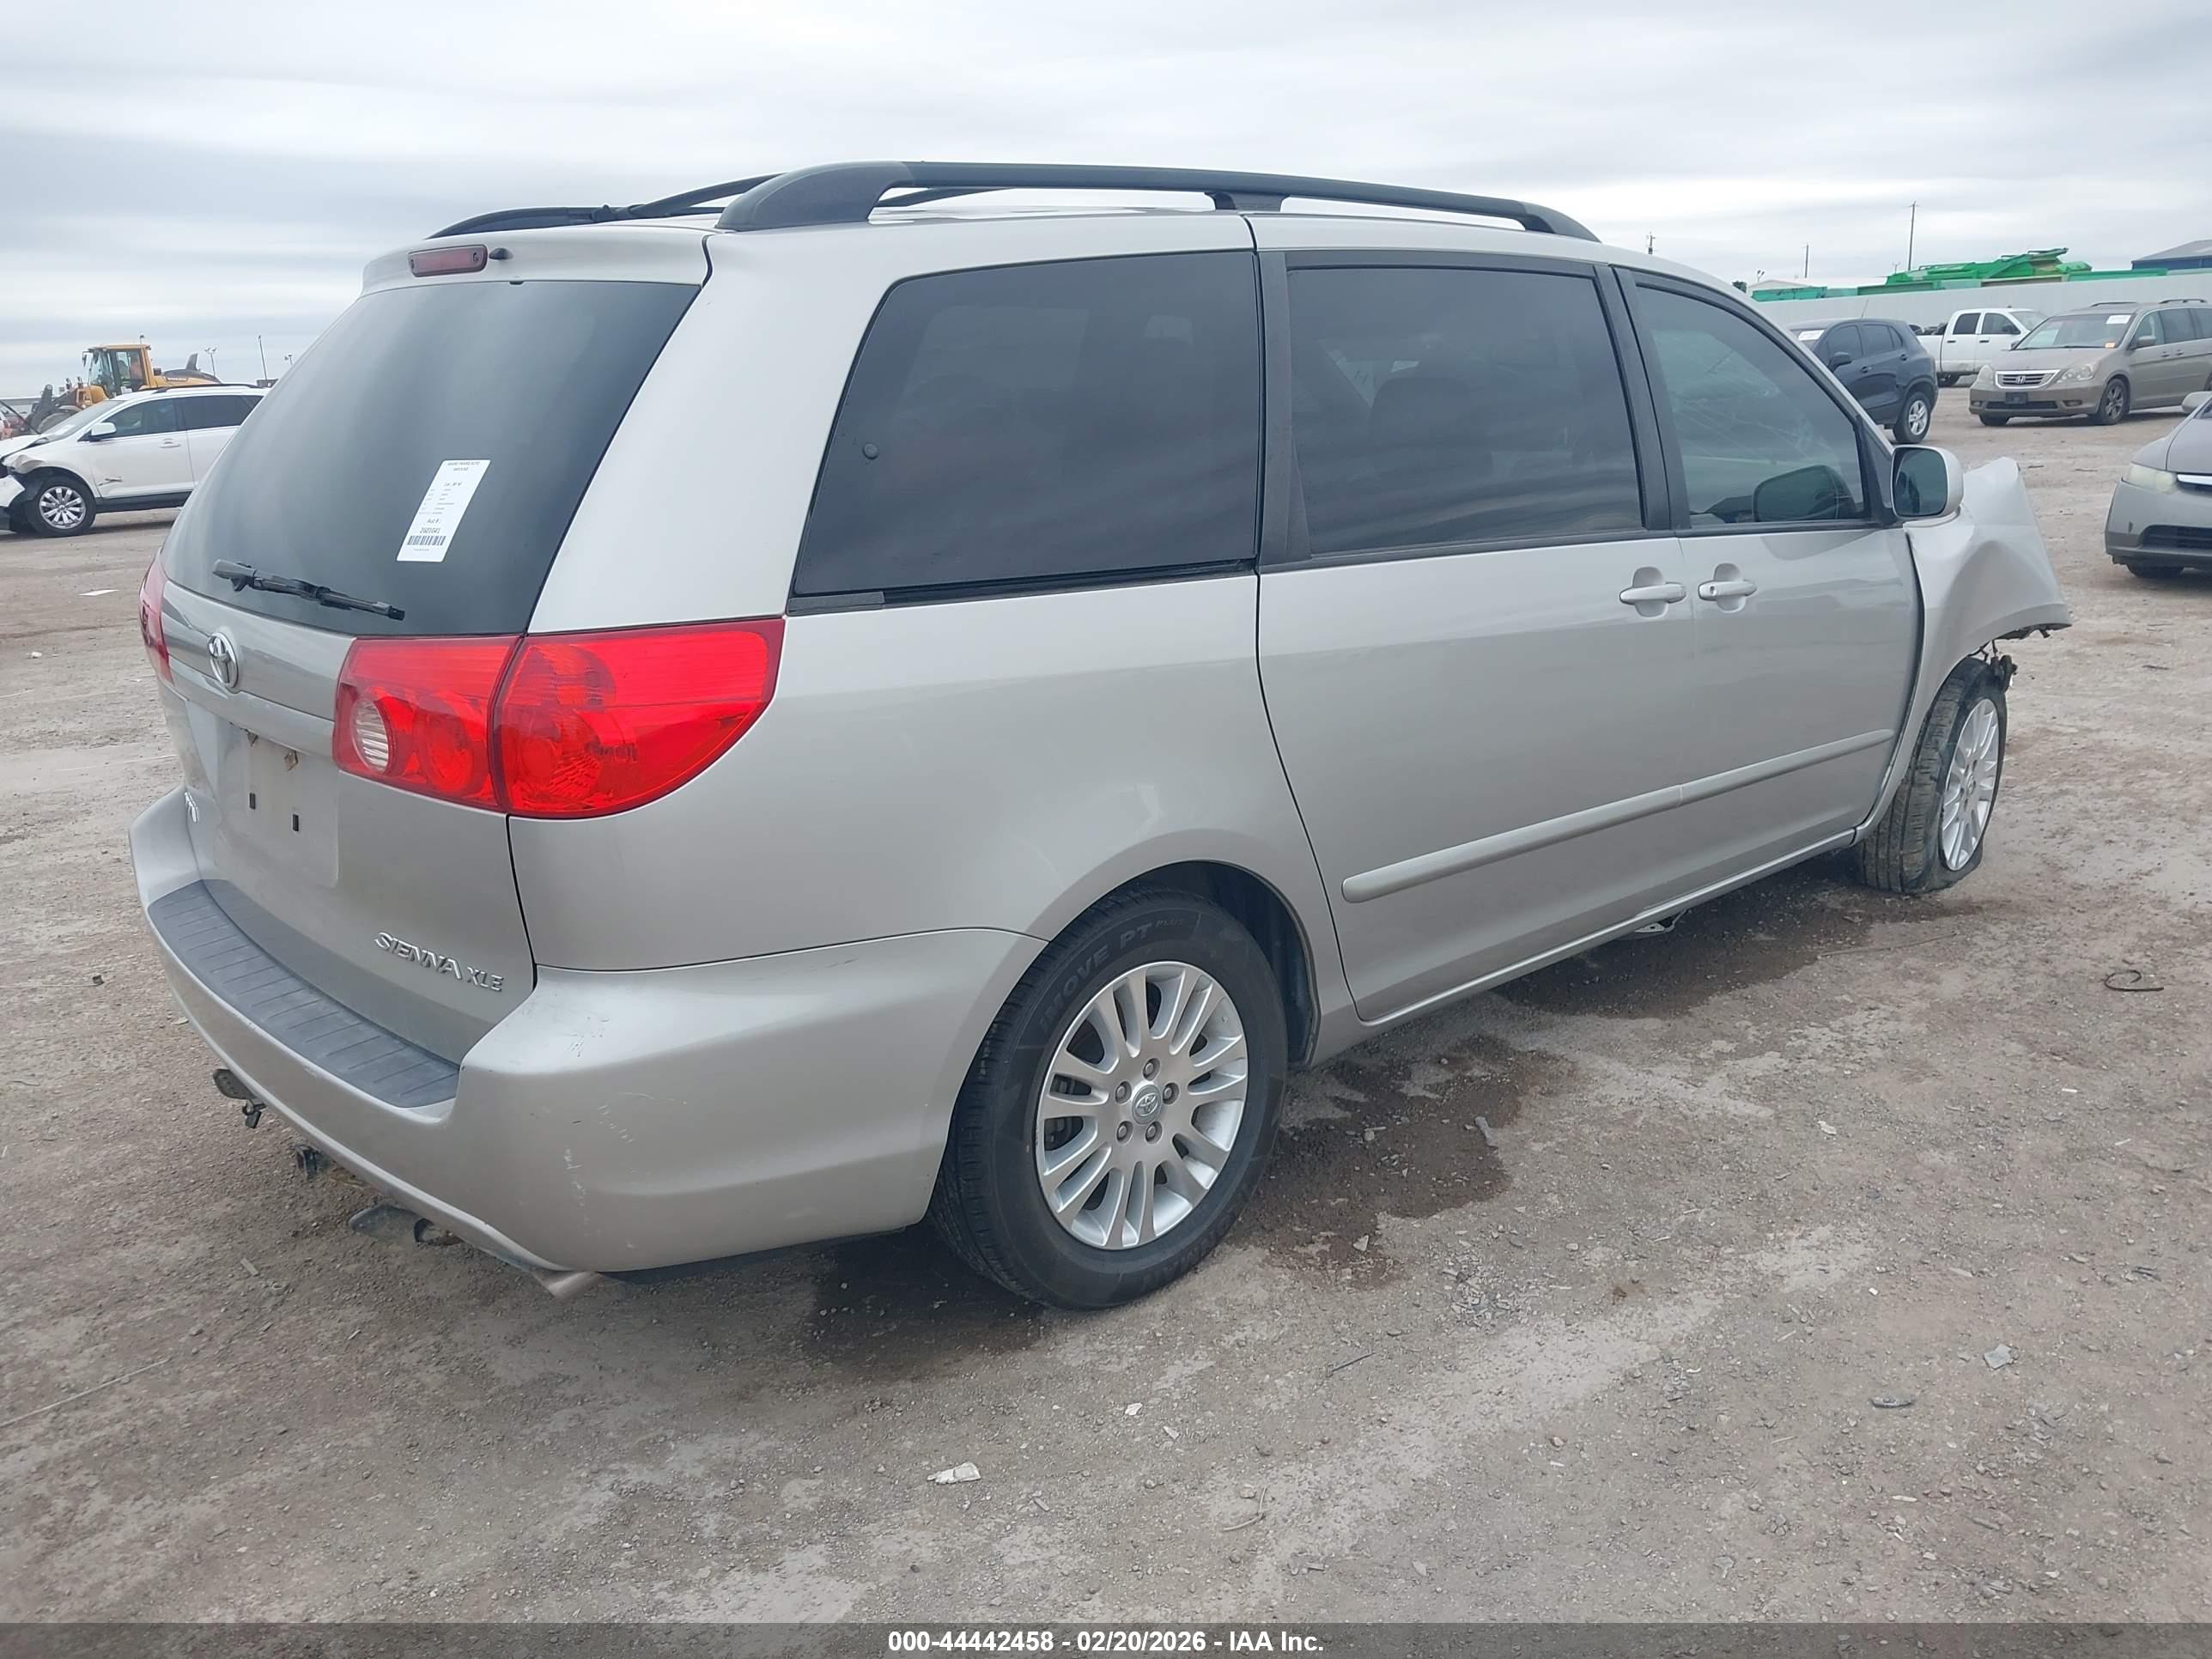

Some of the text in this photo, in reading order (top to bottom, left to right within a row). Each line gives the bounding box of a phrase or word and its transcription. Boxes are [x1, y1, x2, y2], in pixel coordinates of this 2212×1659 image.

[1120, 921, 1153, 949] PT
[374, 931, 505, 993] SIENNA XLE
